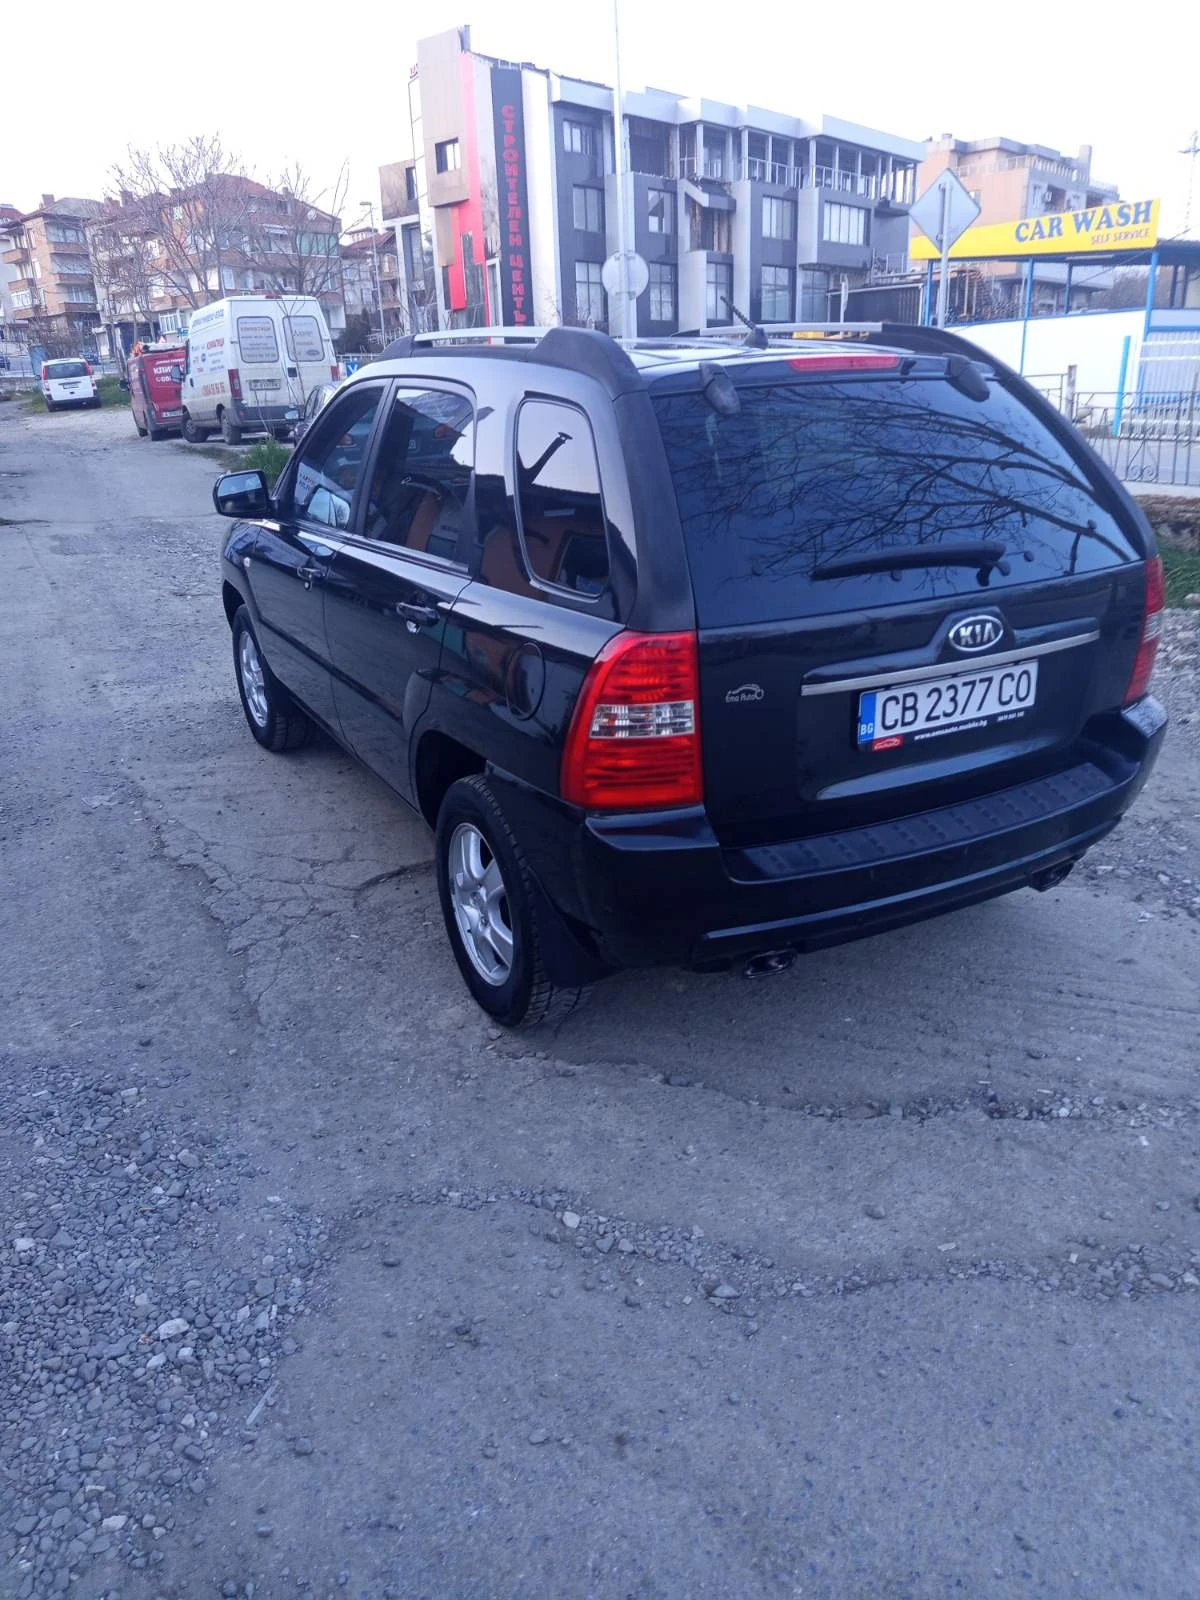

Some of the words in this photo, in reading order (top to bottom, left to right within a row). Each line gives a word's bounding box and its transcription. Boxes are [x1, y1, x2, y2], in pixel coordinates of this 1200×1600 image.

[502, 104, 522, 247] СТРОИТЕЛЕН
[1015, 215, 1063, 243] CAR
[1072, 199, 1154, 234] WASH
[1091, 232, 1111, 245] SELF
[1113, 227, 1151, 243] SERVICE
[509, 254, 527, 326] ЦЕНТЪ
[959, 621, 996, 646] KIA
[881, 691, 919, 731] CB
[925, 675, 994, 723] 2377
[998, 669, 1032, 706] CO
[860, 722, 874, 736] BG
